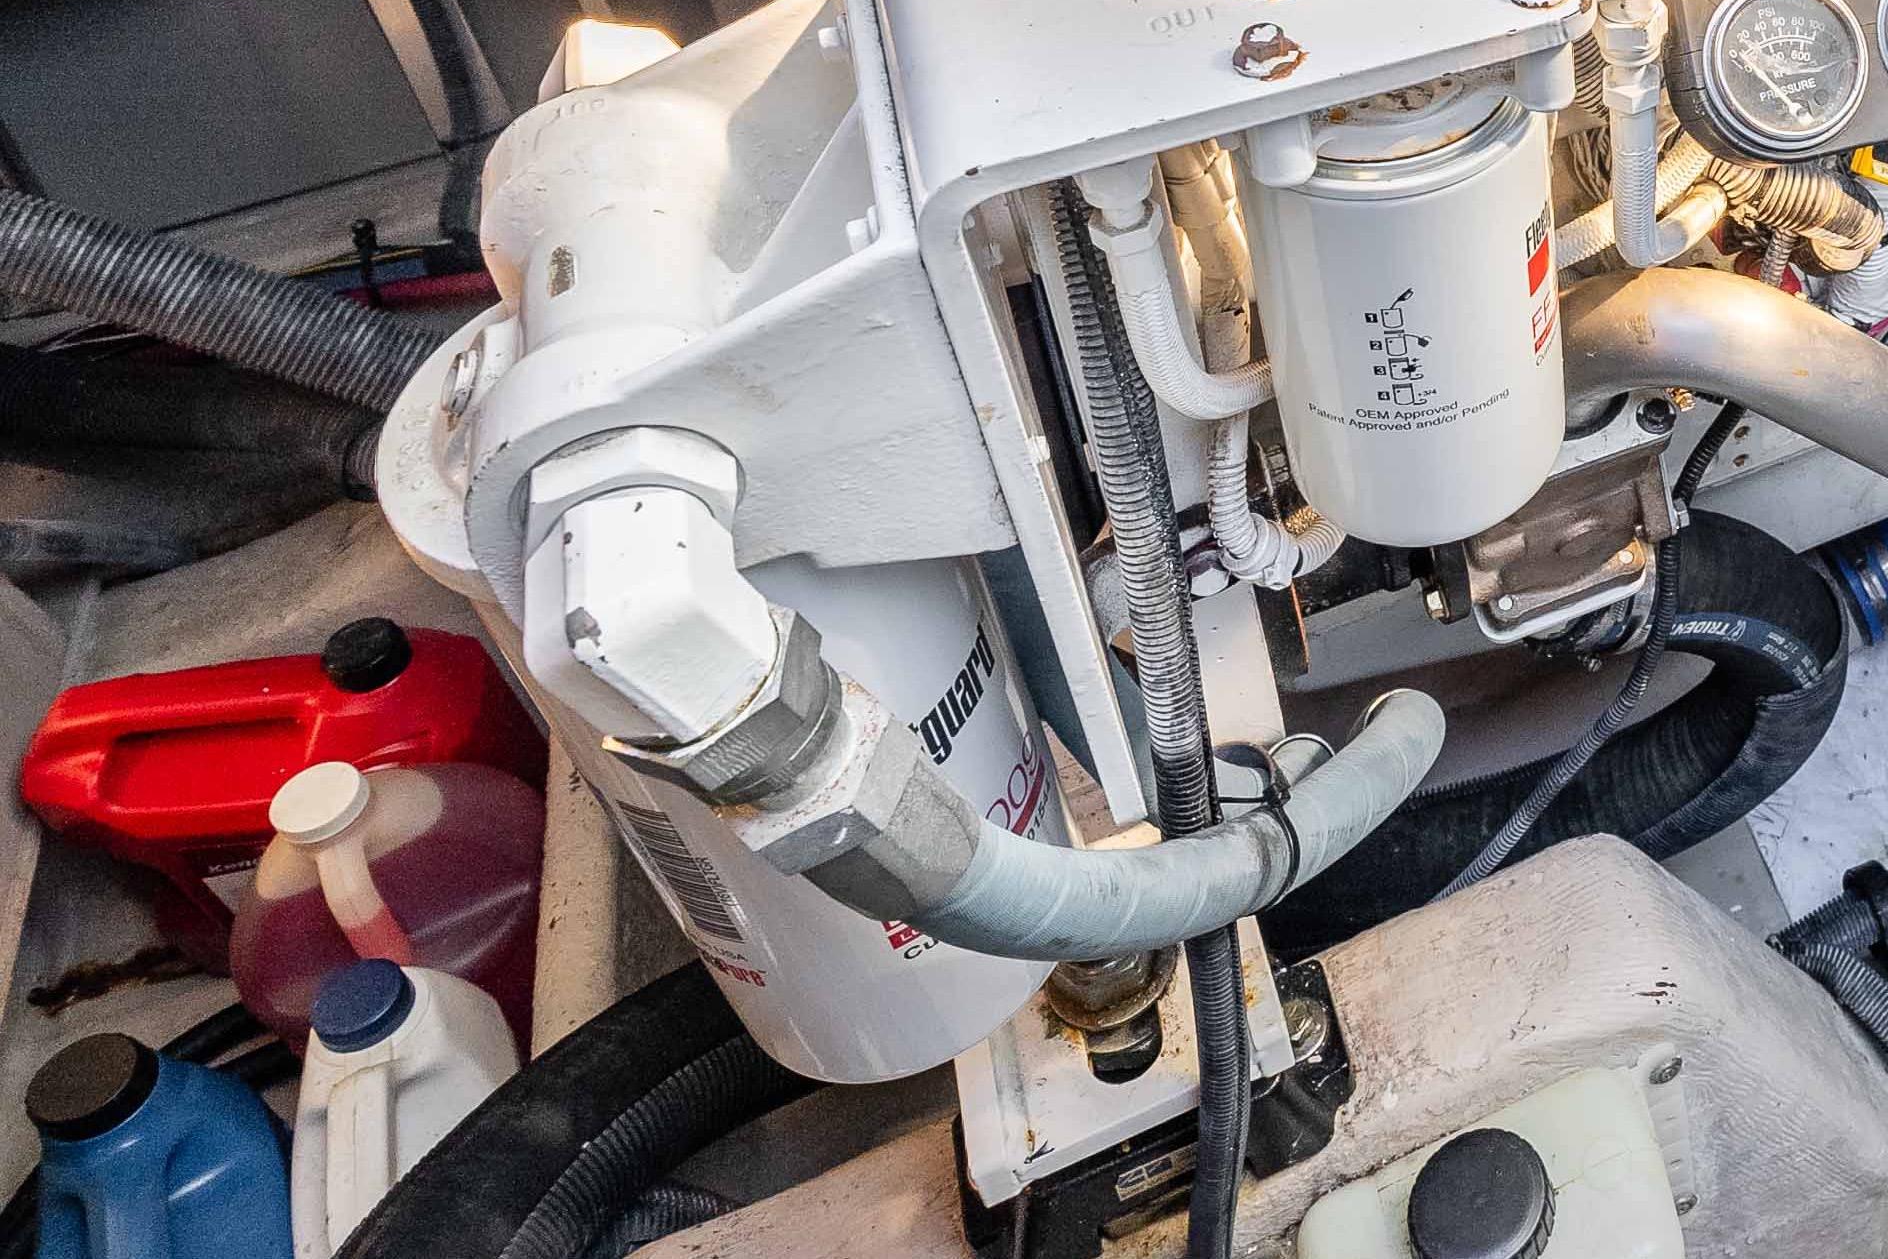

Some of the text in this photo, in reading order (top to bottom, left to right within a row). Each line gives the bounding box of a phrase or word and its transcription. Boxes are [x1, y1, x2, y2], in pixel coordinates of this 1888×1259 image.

[1757, 7, 1776, 19] PSI
[1737, 29, 1750, 43] 20
[1754, 20, 1767, 32] 40
[1760, 78, 1817, 101] PRSSURE
[1307, 388, 1510, 431] Patent Approved and/or Pending
[1355, 401, 1458, 421] OEM Approved
[908, 621, 995, 766] guard
